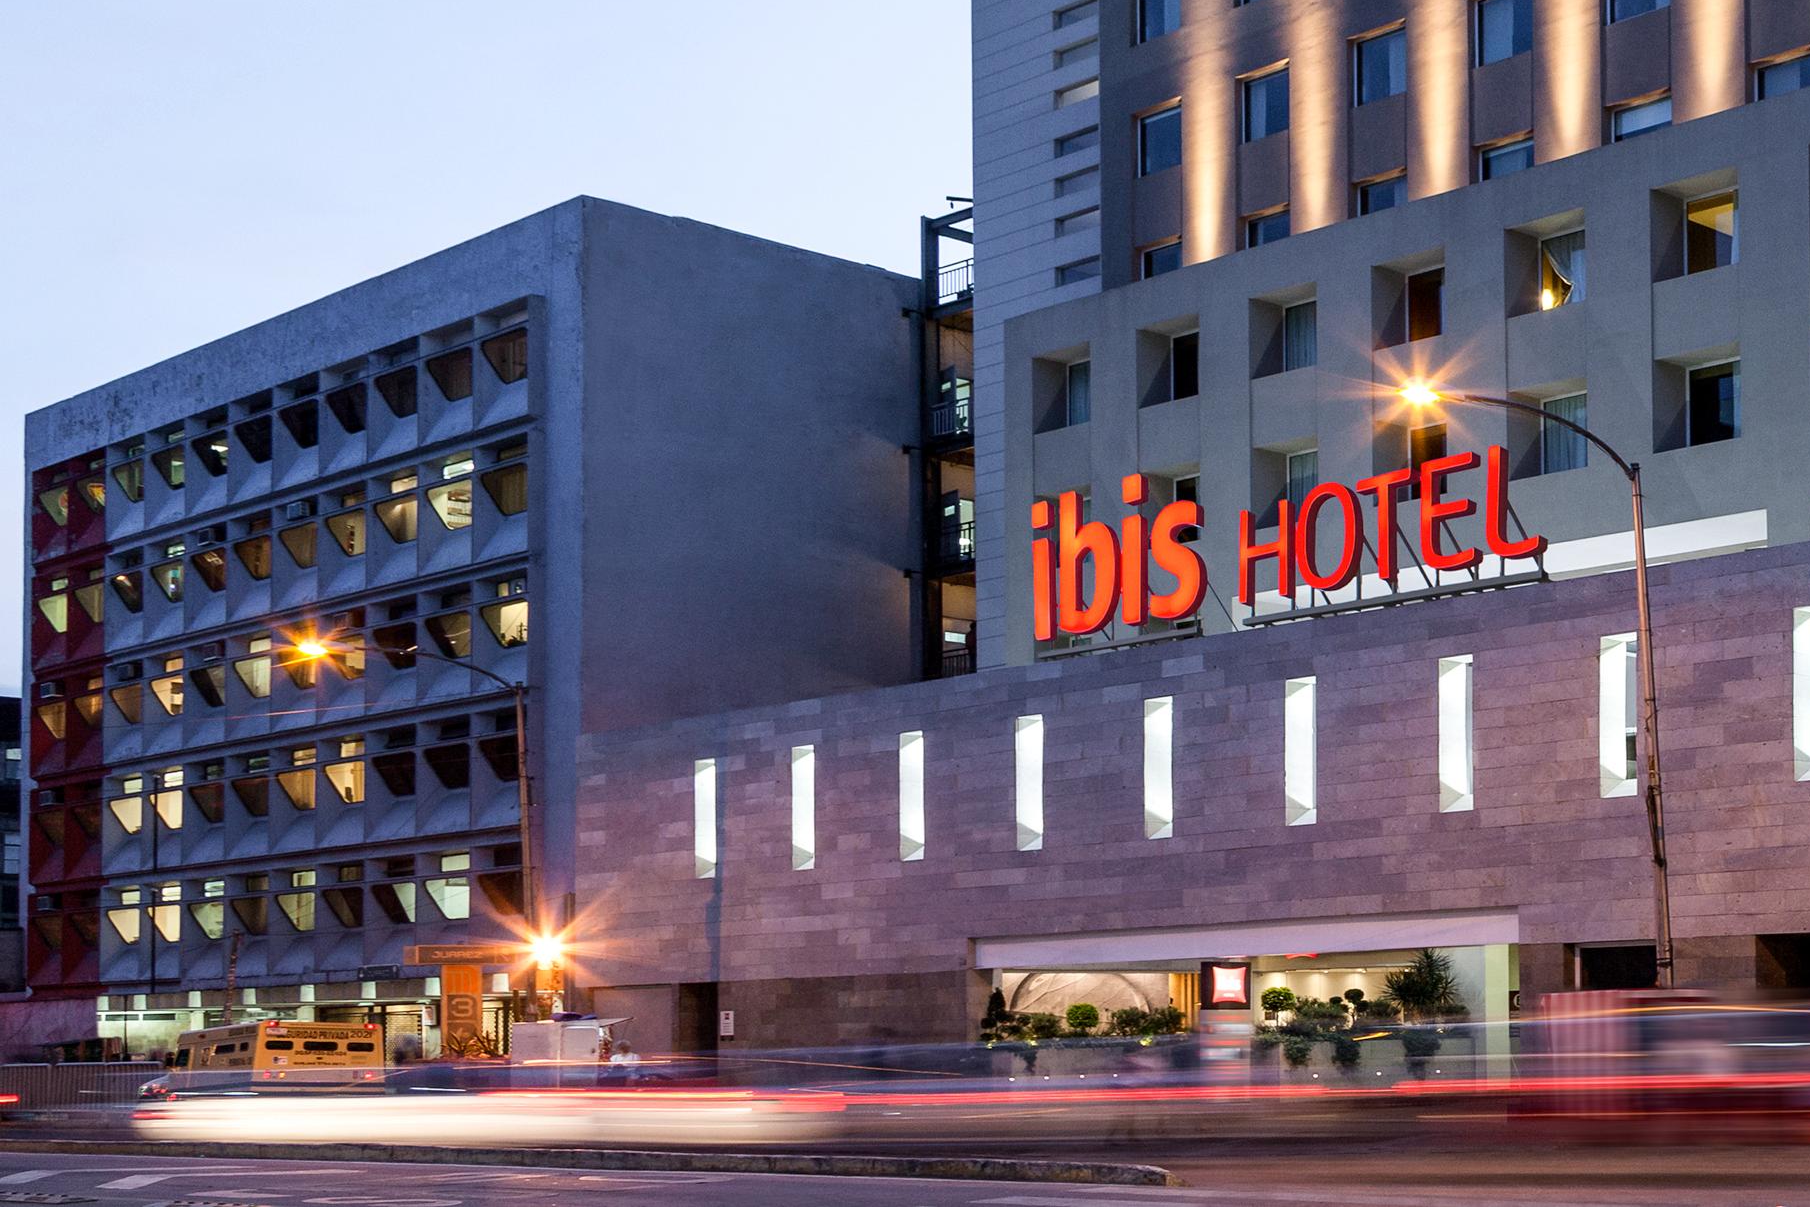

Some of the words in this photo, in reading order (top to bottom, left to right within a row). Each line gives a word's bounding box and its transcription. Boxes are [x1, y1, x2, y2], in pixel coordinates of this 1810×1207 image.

[1031, 473, 1206, 641] ibis
[1239, 444, 1548, 606] HOTEL
[451, 997, 473, 1017] 3
